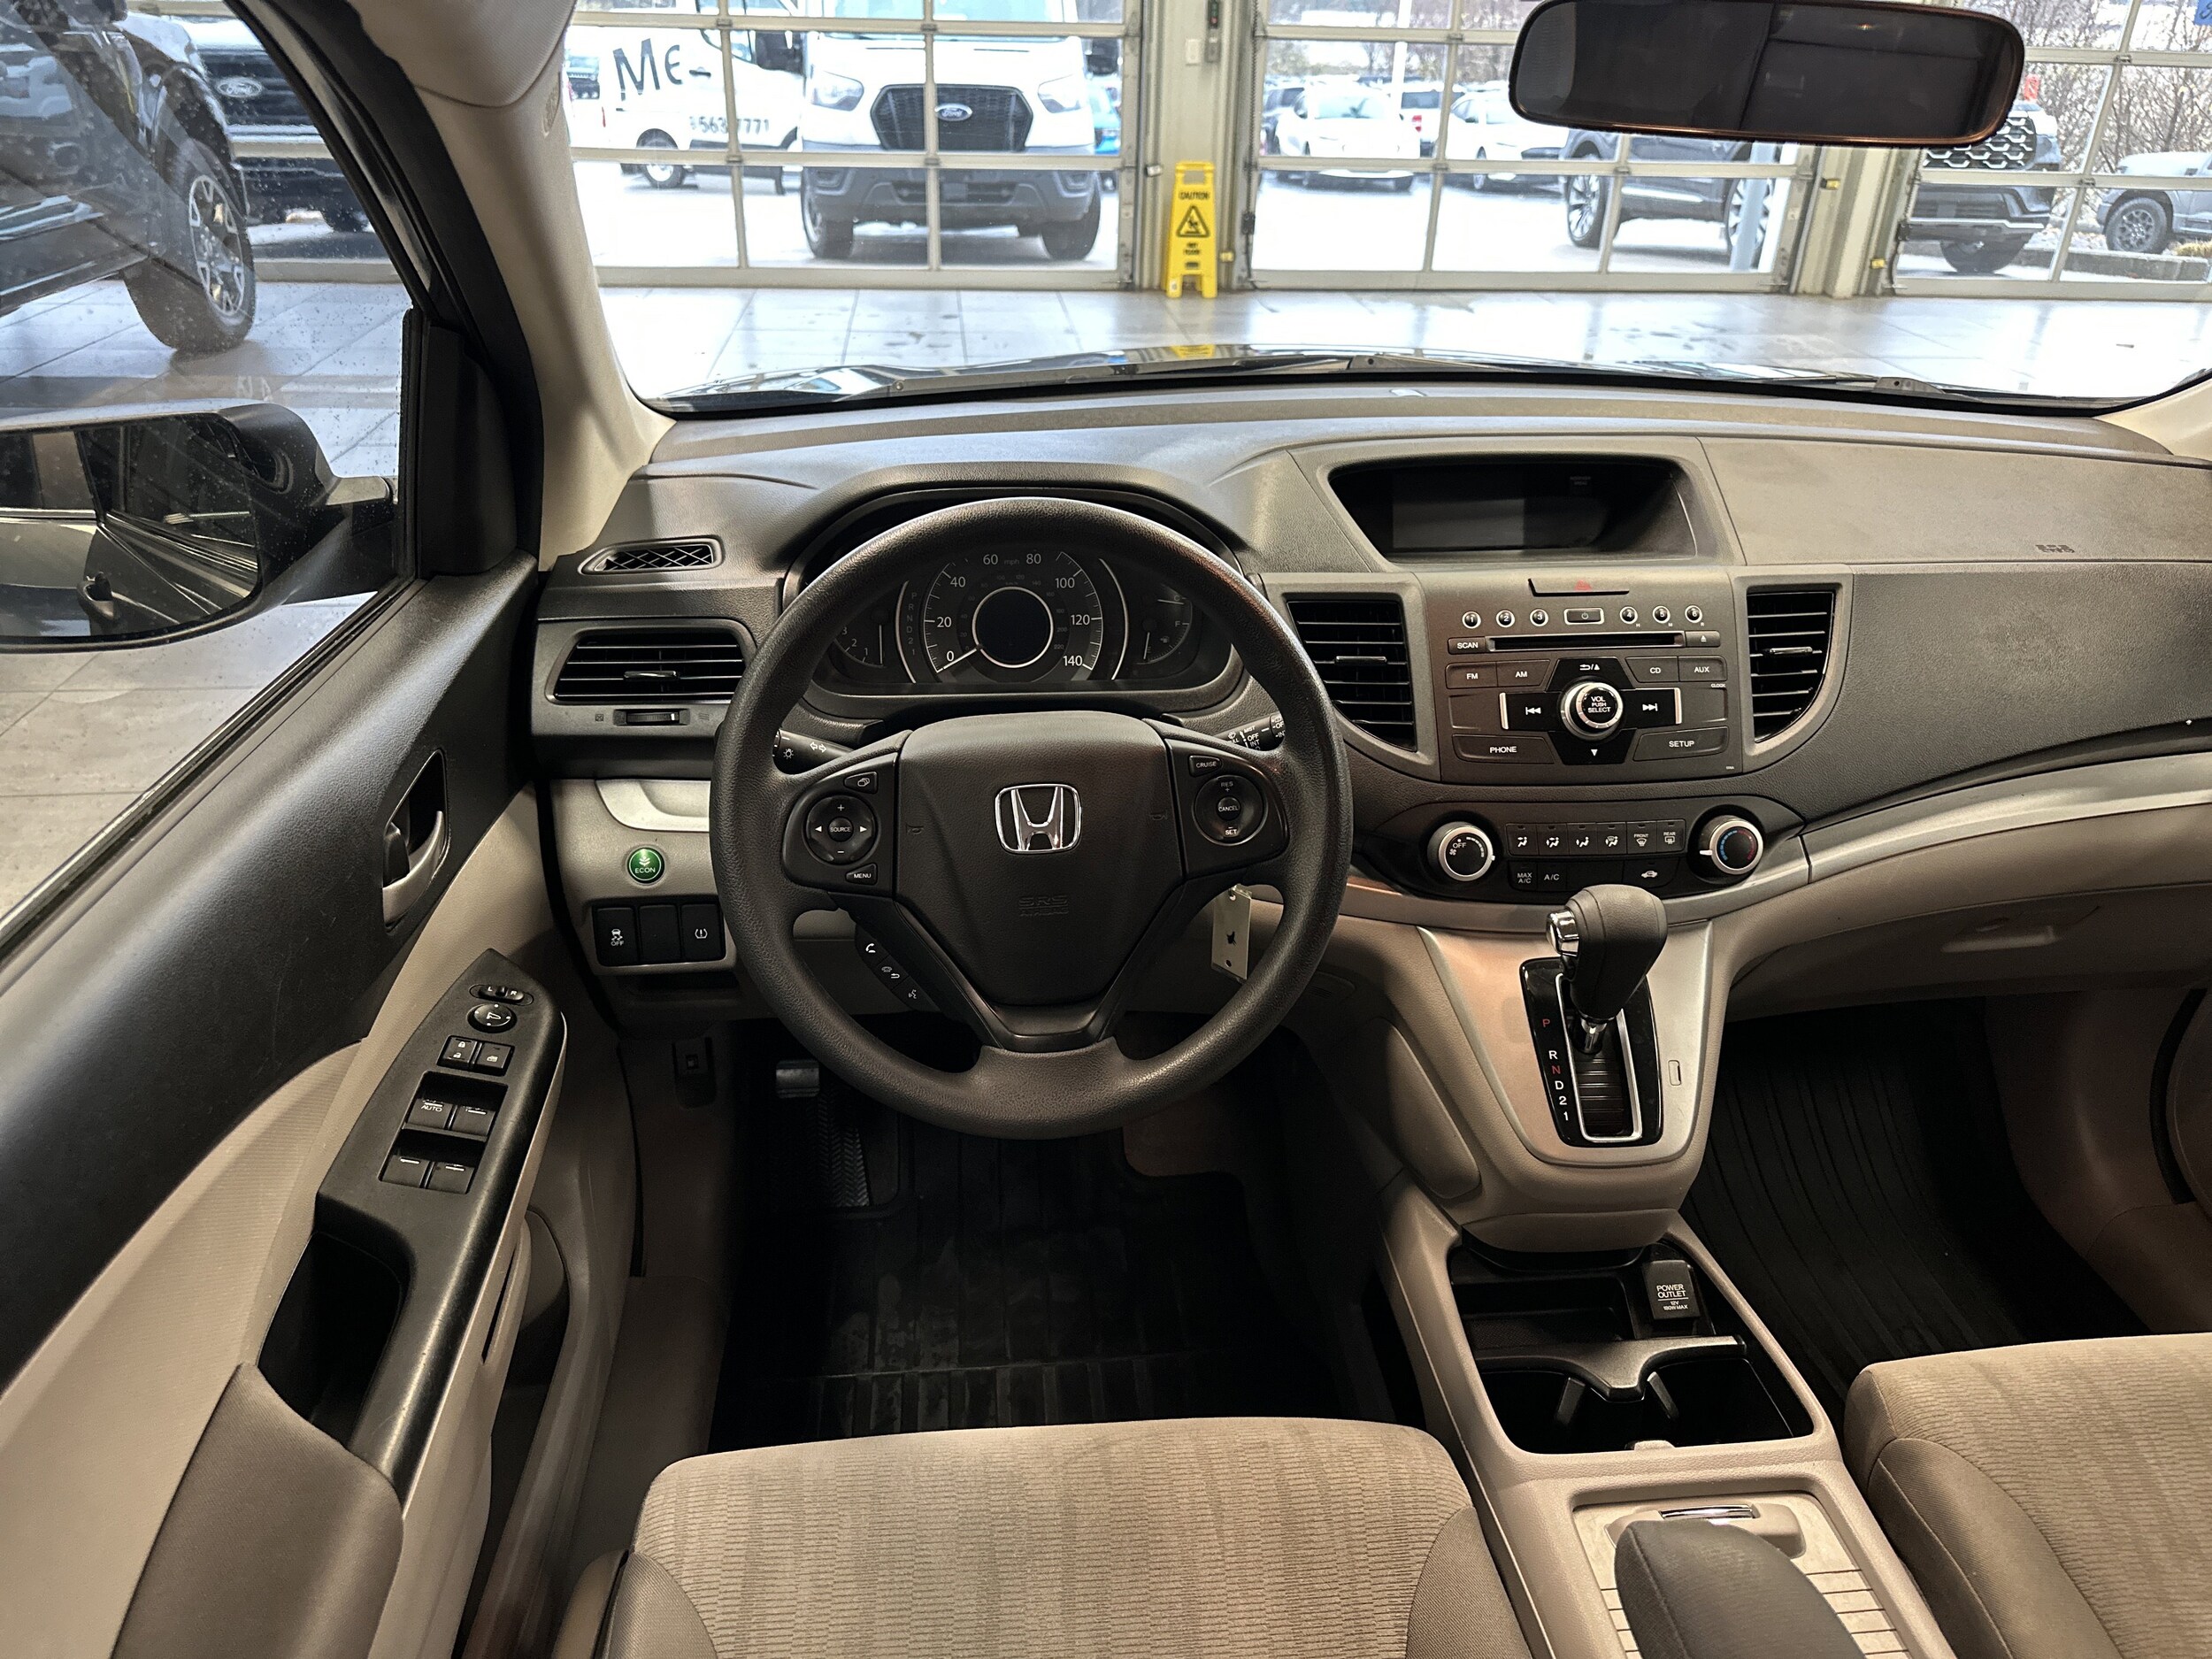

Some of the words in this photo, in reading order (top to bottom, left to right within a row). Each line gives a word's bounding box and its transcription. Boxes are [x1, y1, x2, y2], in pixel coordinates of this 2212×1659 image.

[1179, 191, 1210, 200] CAUTION
[983, 554, 998, 565] 60
[1026, 553, 1041, 565] 80
[950, 576, 966, 588] 40
[1055, 577, 1075, 588] 100
[937, 617, 952, 628] 20
[1071, 614, 1090, 626] 120
[841, 626, 848, 635] 3
[946, 650, 955, 662] 0
[1063, 655, 1083, 666] 140
[1248, 733, 1259, 741] OFF
[1542, 1018, 1551, 1028] P
[1548, 1049, 1558, 1060] R
[1551, 1065, 1561, 1075] N
[1555, 1080, 1564, 1090] D
[1559, 1095, 1568, 1105] 2
[1563, 1110, 1569, 1121] 1
[1656, 1283, 1684, 1292] POWER
[1657, 1290, 1686, 1299] OUTLET
